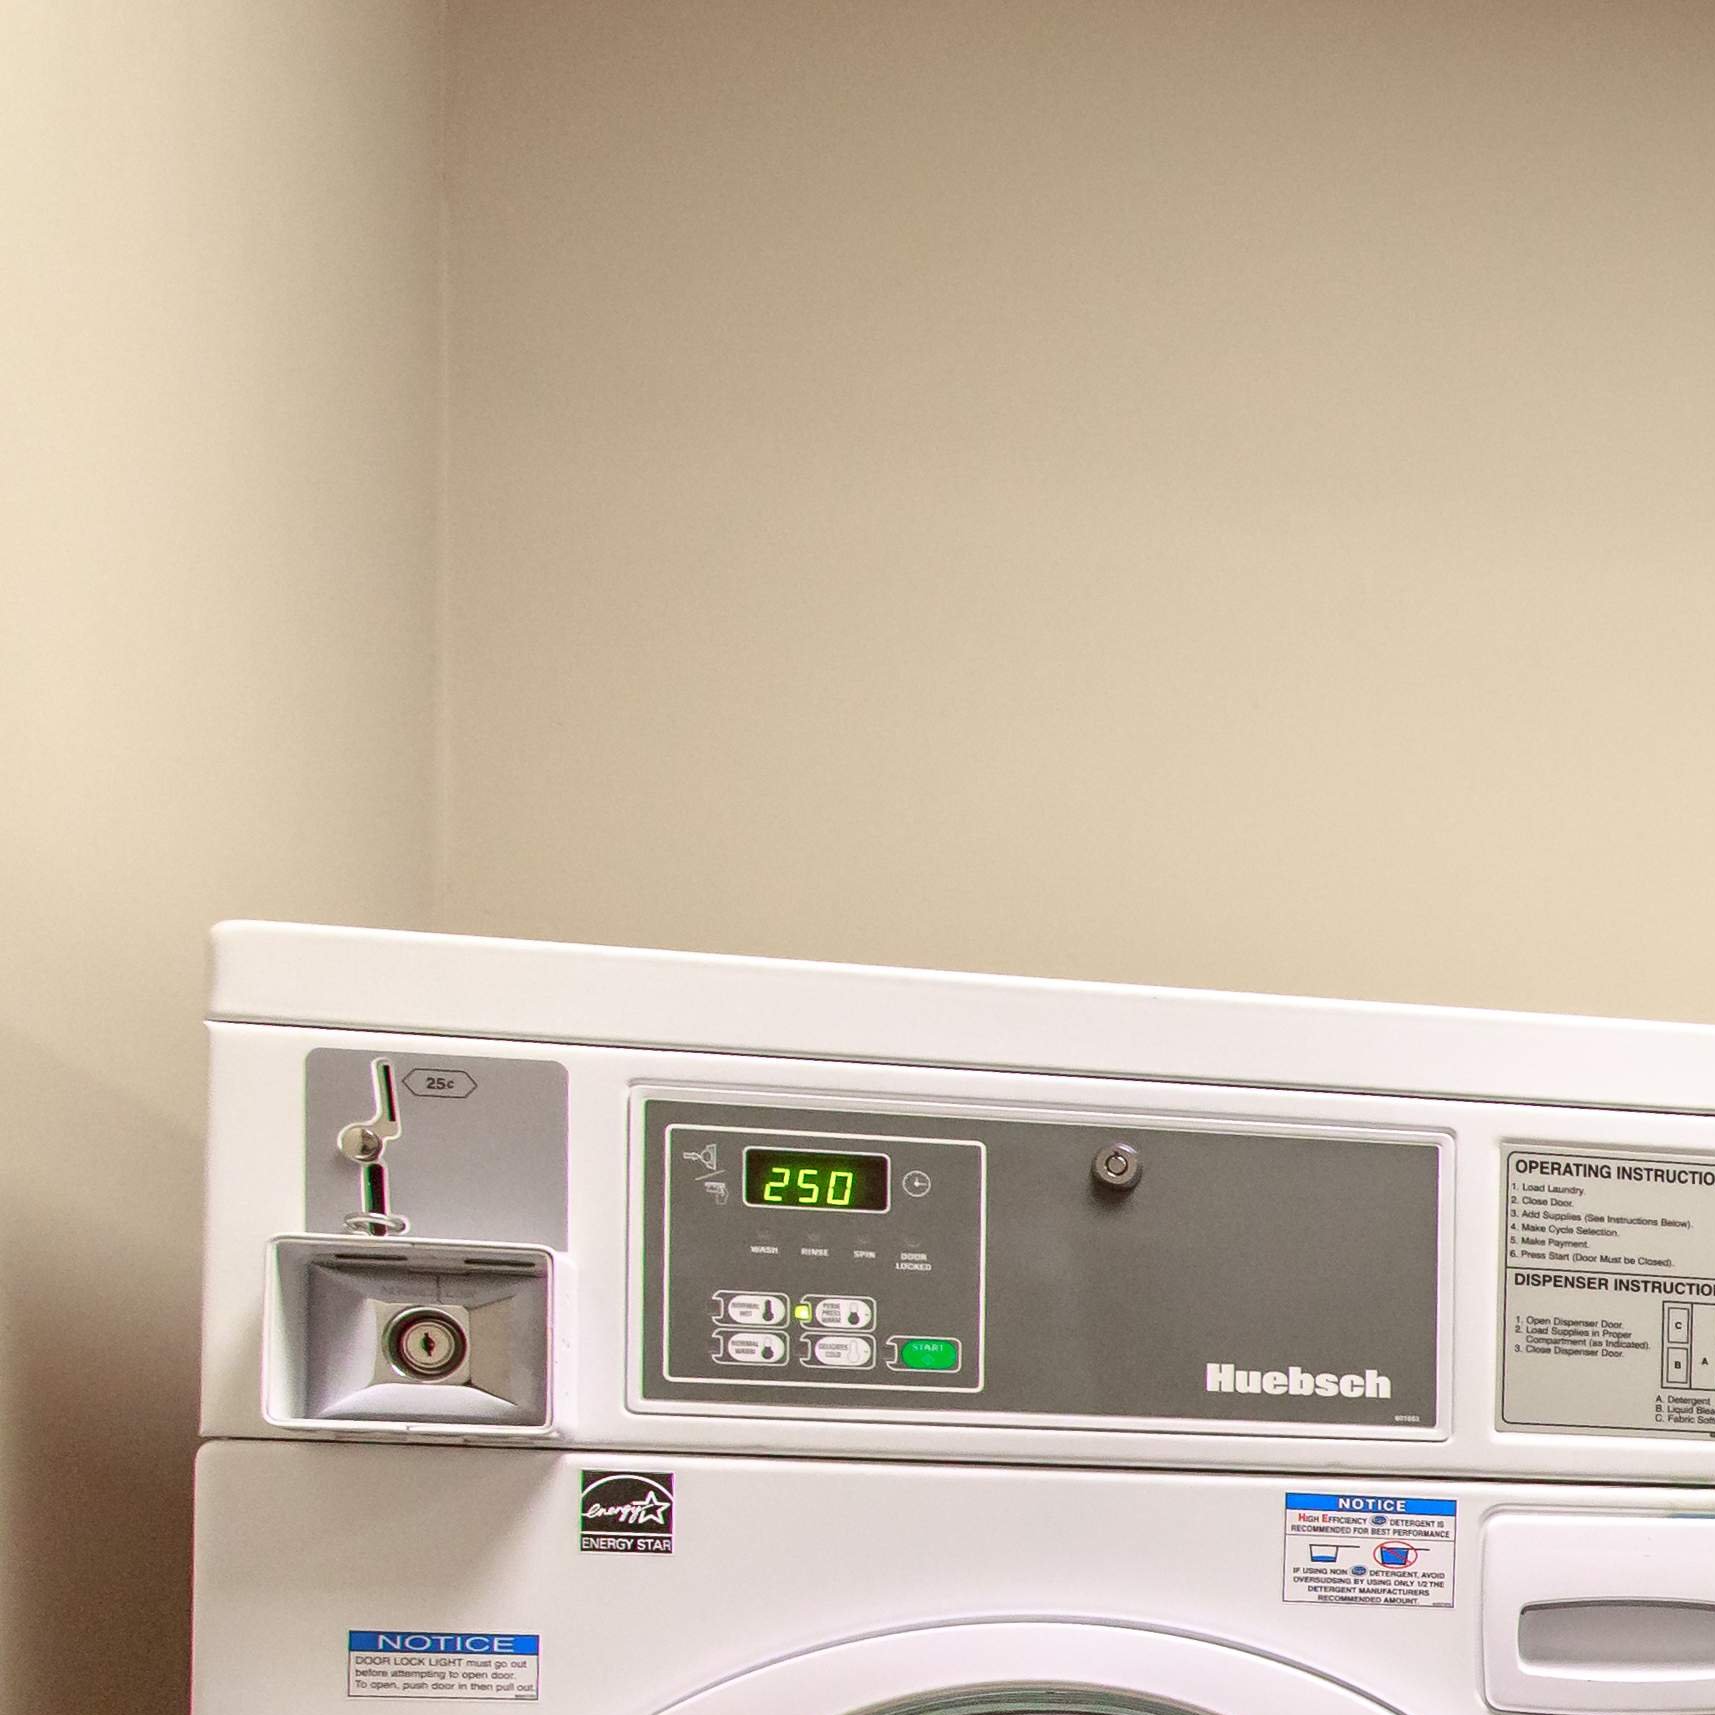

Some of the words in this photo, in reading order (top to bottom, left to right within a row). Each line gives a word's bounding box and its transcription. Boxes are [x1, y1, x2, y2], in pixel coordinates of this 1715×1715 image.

[1516, 1160, 1611, 1178] OPERATING
[763, 1168, 853, 1206] 250
[1522, 1183, 1545, 1192] Load
[1522, 1196, 1548, 1206] Close
[1522, 1210, 1540, 1218] Add
[1542, 1211, 1582, 1221] Supplies
[1607, 1216, 1658, 1226] Instructions
[1522, 1224, 1546, 1232] Make
[1549, 1226, 1574, 1234] Cycle
[1522, 1238, 1546, 1246] Make
[1521, 1251, 1546, 1259] Press
[1548, 1252, 1569, 1261] Start
[1600, 1255, 1622, 1264] Must
[1515, 1273, 1608, 1290] DISPENSER
[1526, 1316, 1551, 1326] Open
[1554, 1318, 1598, 1327] Dispenser
[1526, 1326, 1548, 1334] Load
[1551, 1328, 1589, 1337] Supplies
[1602, 1330, 1632, 1339] Proper
[1674, 1361, 1681, 1369] B
[1206, 1363, 1391, 1398] Huebsch
[1668, 1395, 1710, 1406] Detergent
[1667, 1405, 1696, 1415] Liquid
[1668, 1414, 1695, 1423] Fabric
[1339, 1498, 1405, 1511] NOTICE
[582, 1538, 633, 1550] ENERGY
[638, 1539, 670, 1550] STAR
[379, 1635, 514, 1652] NOTICE
